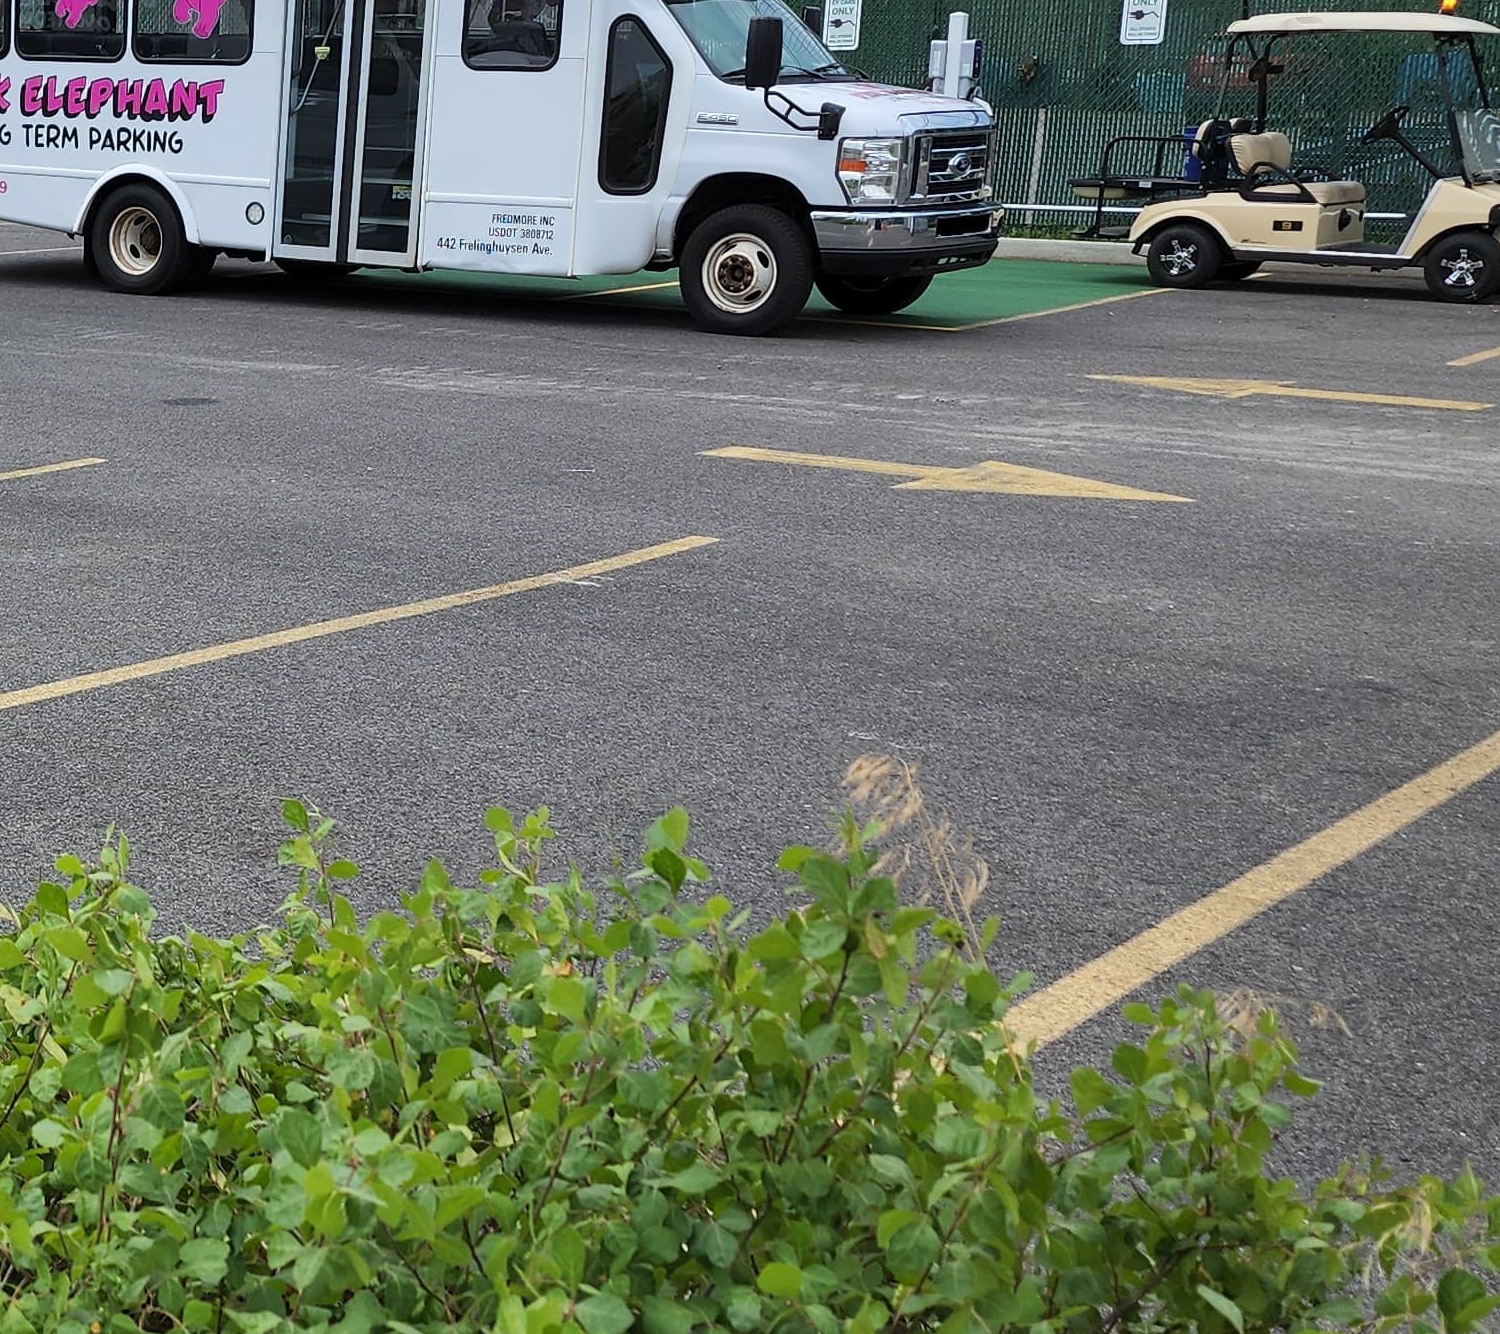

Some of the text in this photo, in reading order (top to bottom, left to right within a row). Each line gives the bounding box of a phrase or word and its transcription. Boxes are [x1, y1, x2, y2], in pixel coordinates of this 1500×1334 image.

[832, 7, 854, 15] ONLY
[20, 75, 225, 124] ELEPHANT
[22, 123, 79, 150] TERM
[89, 127, 184, 155] PARKING
[492, 214, 555, 226] FREDMORE INC
[488, 227, 517, 238] USDOT
[436, 237, 553, 256] 442 Frelinghuysen Ave.
